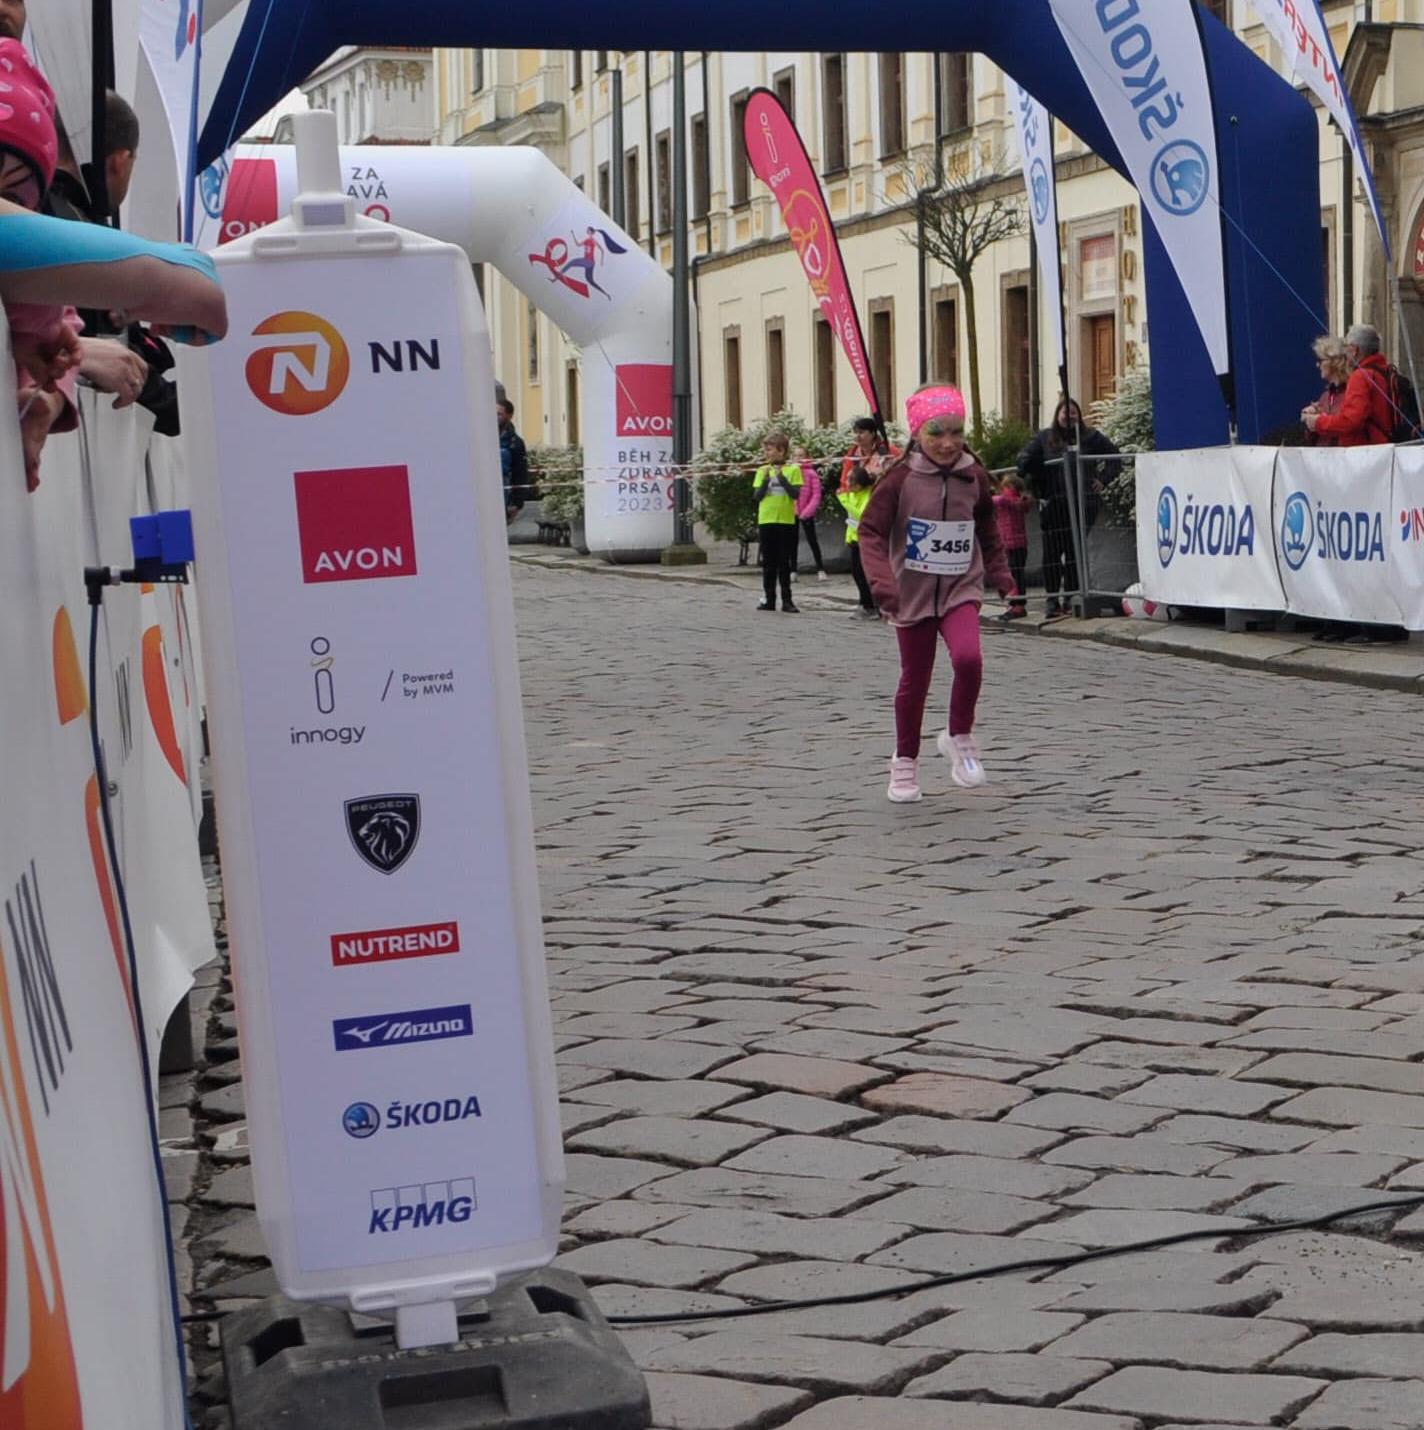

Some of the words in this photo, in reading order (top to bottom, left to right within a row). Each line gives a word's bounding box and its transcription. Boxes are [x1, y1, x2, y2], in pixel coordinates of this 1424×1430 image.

[351, 167, 379, 180] ZA
[347, 182, 389, 199] AVÁ
[369, 338, 441, 374] NN
[618, 448, 651, 463] BĚH
[658, 450, 673, 463] Z
[618, 466, 675, 480] ZDRAV
[618, 482, 661, 495] PRSA
[617, 497, 663, 512] 2023
[1180, 494, 1255, 556] ŠKODA
[1317, 501, 1386, 563] ŠKODA
[930, 538, 971, 554] 3456
[314, 546, 403, 572] AVON
[401, 669, 455, 685] Powered
[403, 686, 418, 699] by
[422, 682, 455, 696] MVM
[289, 725, 367, 746] innogy
[338, 929, 454, 960] NUTREND
[385, 1095, 482, 1129] ŠKODA
[368, 1195, 474, 1234] KPMG
